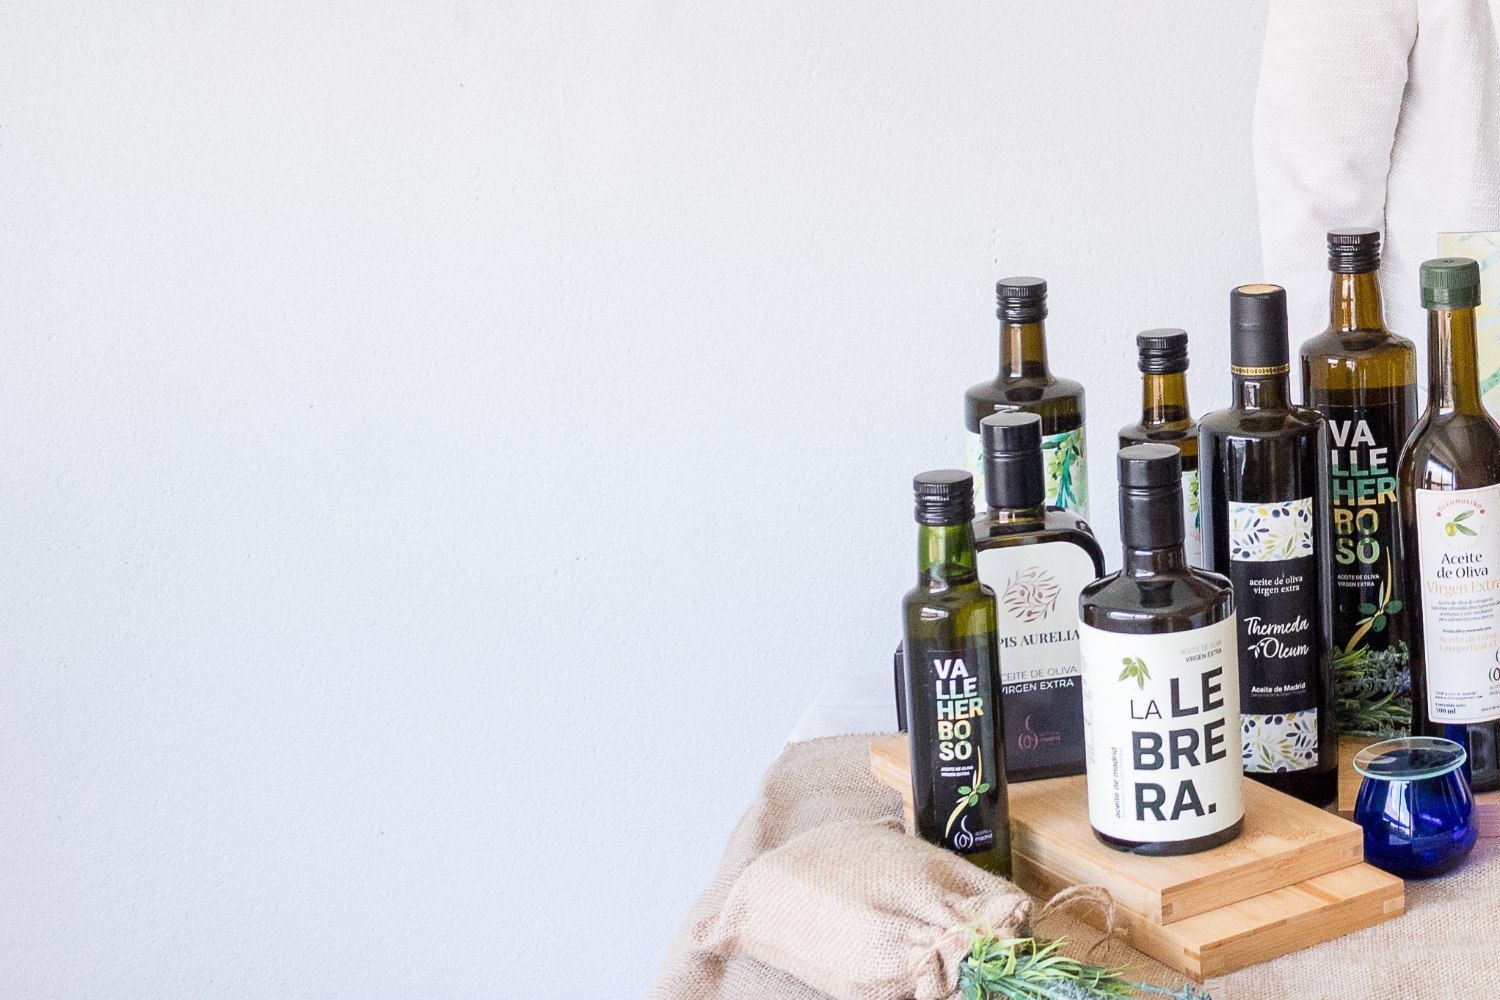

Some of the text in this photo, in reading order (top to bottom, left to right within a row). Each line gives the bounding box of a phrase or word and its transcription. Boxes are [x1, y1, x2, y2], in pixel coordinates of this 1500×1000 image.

[1329, 420, 1376, 447] VA
[1331, 447, 1388, 477] LLE
[1332, 476, 1397, 506] HER
[1334, 508, 1378, 536] BO
[1335, 537, 1380, 565] SO
[1441, 552, 1482, 565] Aceite
[1249, 575, 1303, 586] aceite de oliva
[1437, 566, 1488, 579] de Oliva
[1254, 584, 1300, 596] virgen extra
[1427, 581, 1467, 598] Virgen
[1244, 615, 1309, 635] Thermeda
[1021, 629, 1080, 647] AURELIA
[1263, 637, 1309, 659] Oleum
[933, 658, 969, 679] VA
[1001, 665, 1078, 682] CEITE DE OLIVA
[935, 677, 978, 700] LLE
[1040, 678, 1074, 690] EXTRA
[1131, 666, 1224, 720] LA LE
[1251, 682, 1306, 693] Aceite de Madrid
[937, 697, 984, 720] HER
[937, 720, 971, 740] BO
[939, 740, 972, 761] SO
[1132, 718, 1227, 770] BRE
[1135, 779, 1217, 821] RA.
